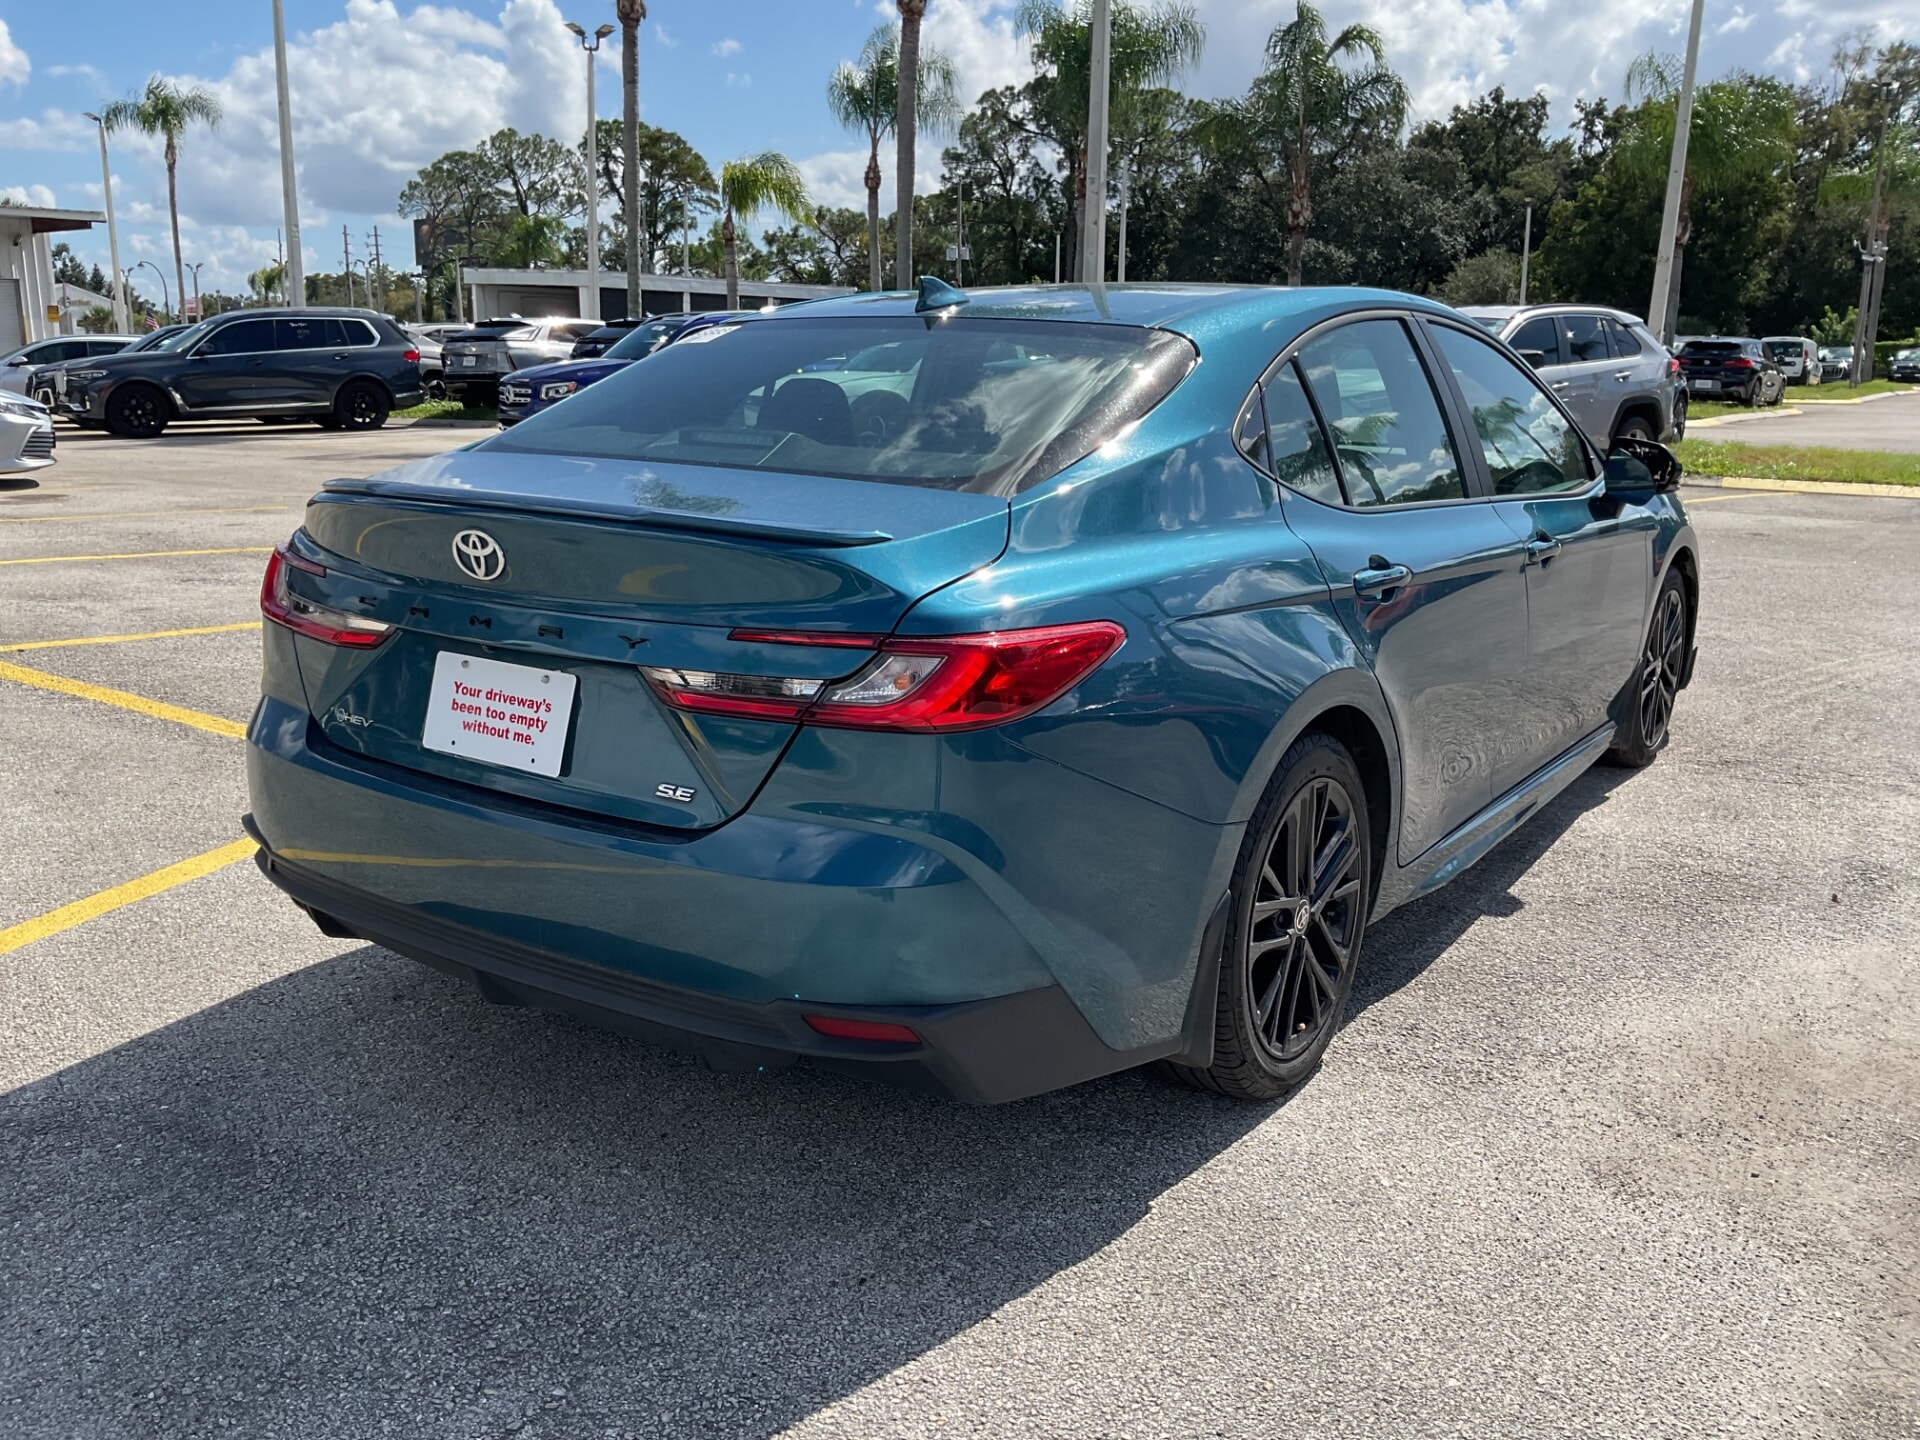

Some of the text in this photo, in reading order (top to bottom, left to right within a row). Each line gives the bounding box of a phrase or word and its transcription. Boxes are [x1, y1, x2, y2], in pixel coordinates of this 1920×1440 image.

[358, 595, 651, 649] CAMRY
[454, 681, 552, 713] Your driveway's
[345, 713, 374, 728] HEV
[451, 698, 548, 733] been too empty
[462, 720, 535, 745] without me.
[655, 783, 696, 802] SE
